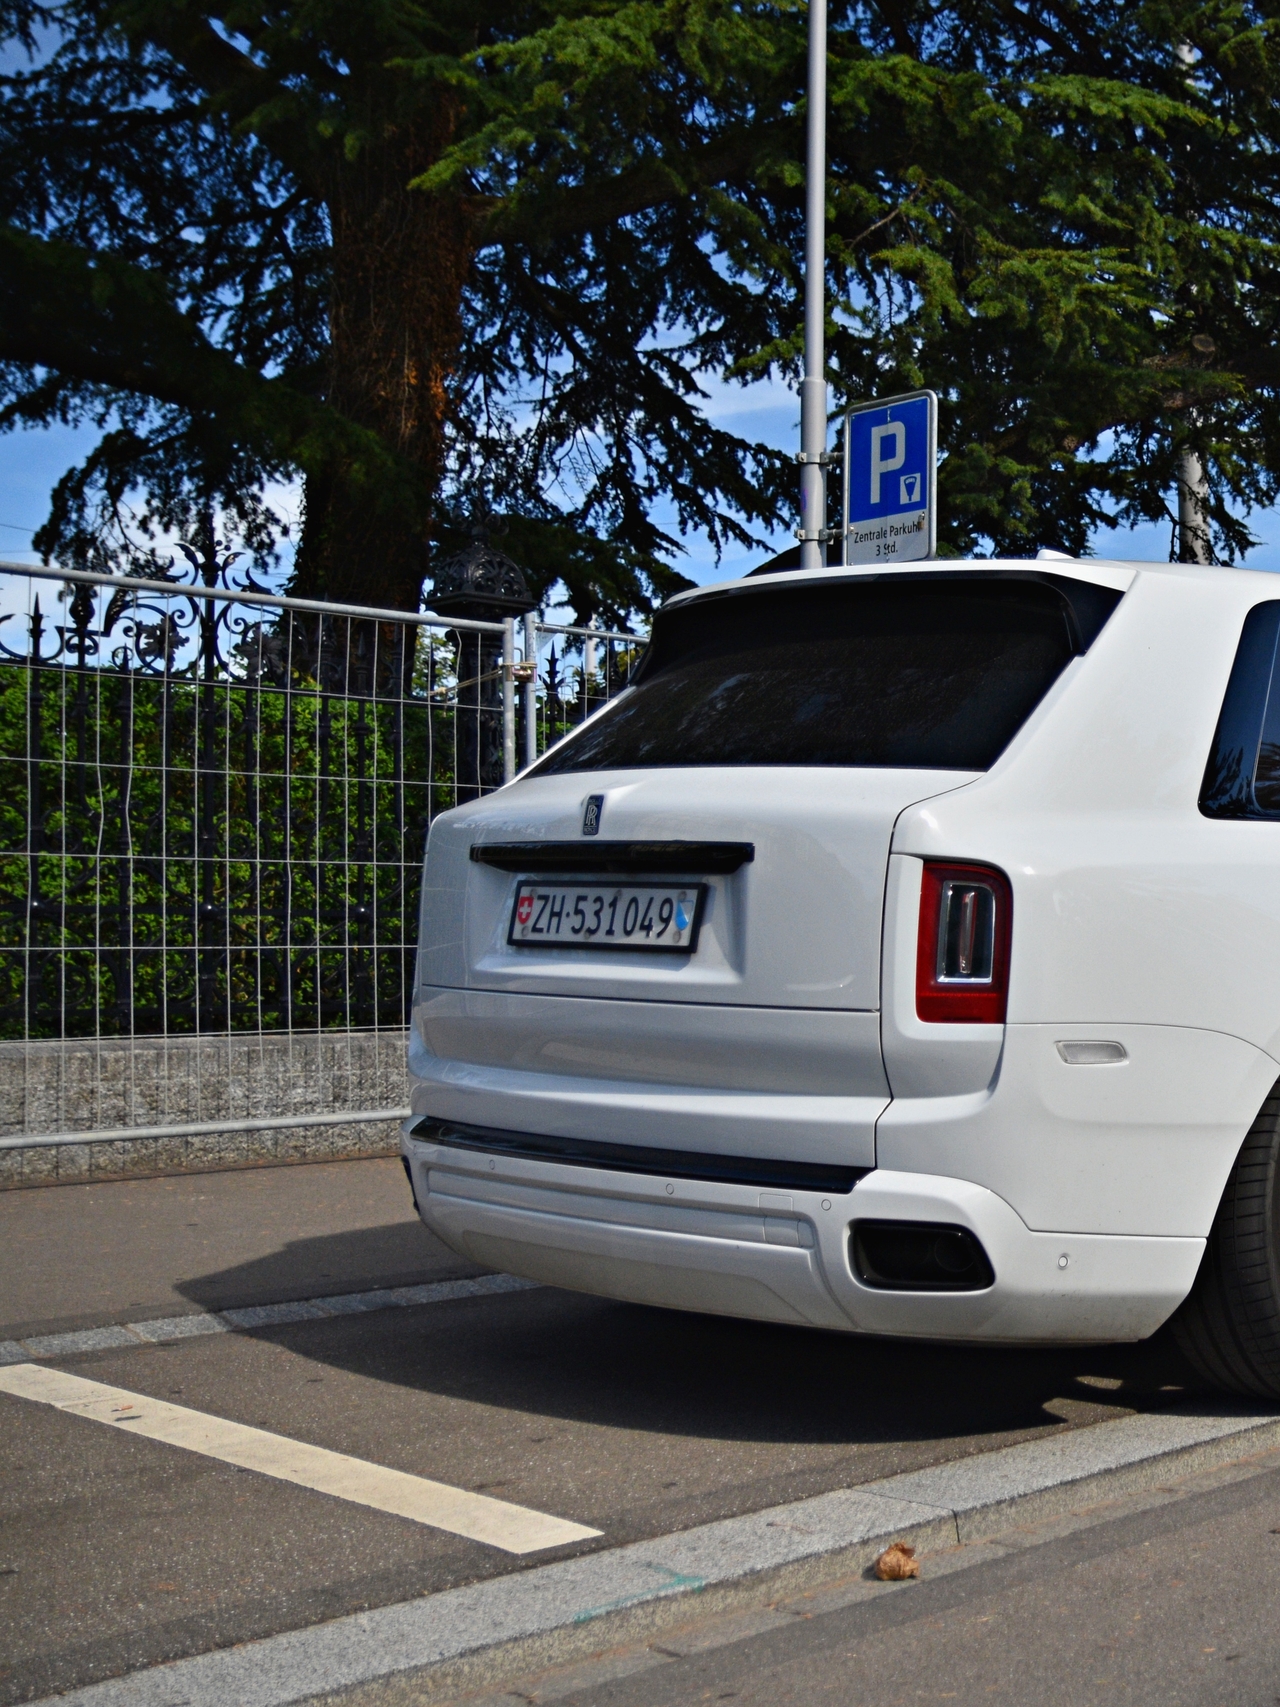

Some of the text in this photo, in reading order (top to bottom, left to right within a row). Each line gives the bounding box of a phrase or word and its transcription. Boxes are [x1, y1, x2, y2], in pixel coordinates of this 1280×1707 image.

[870, 421, 906, 505] P
[854, 526, 888, 544] Zentrale
[875, 540, 898, 557] 3 Std.
